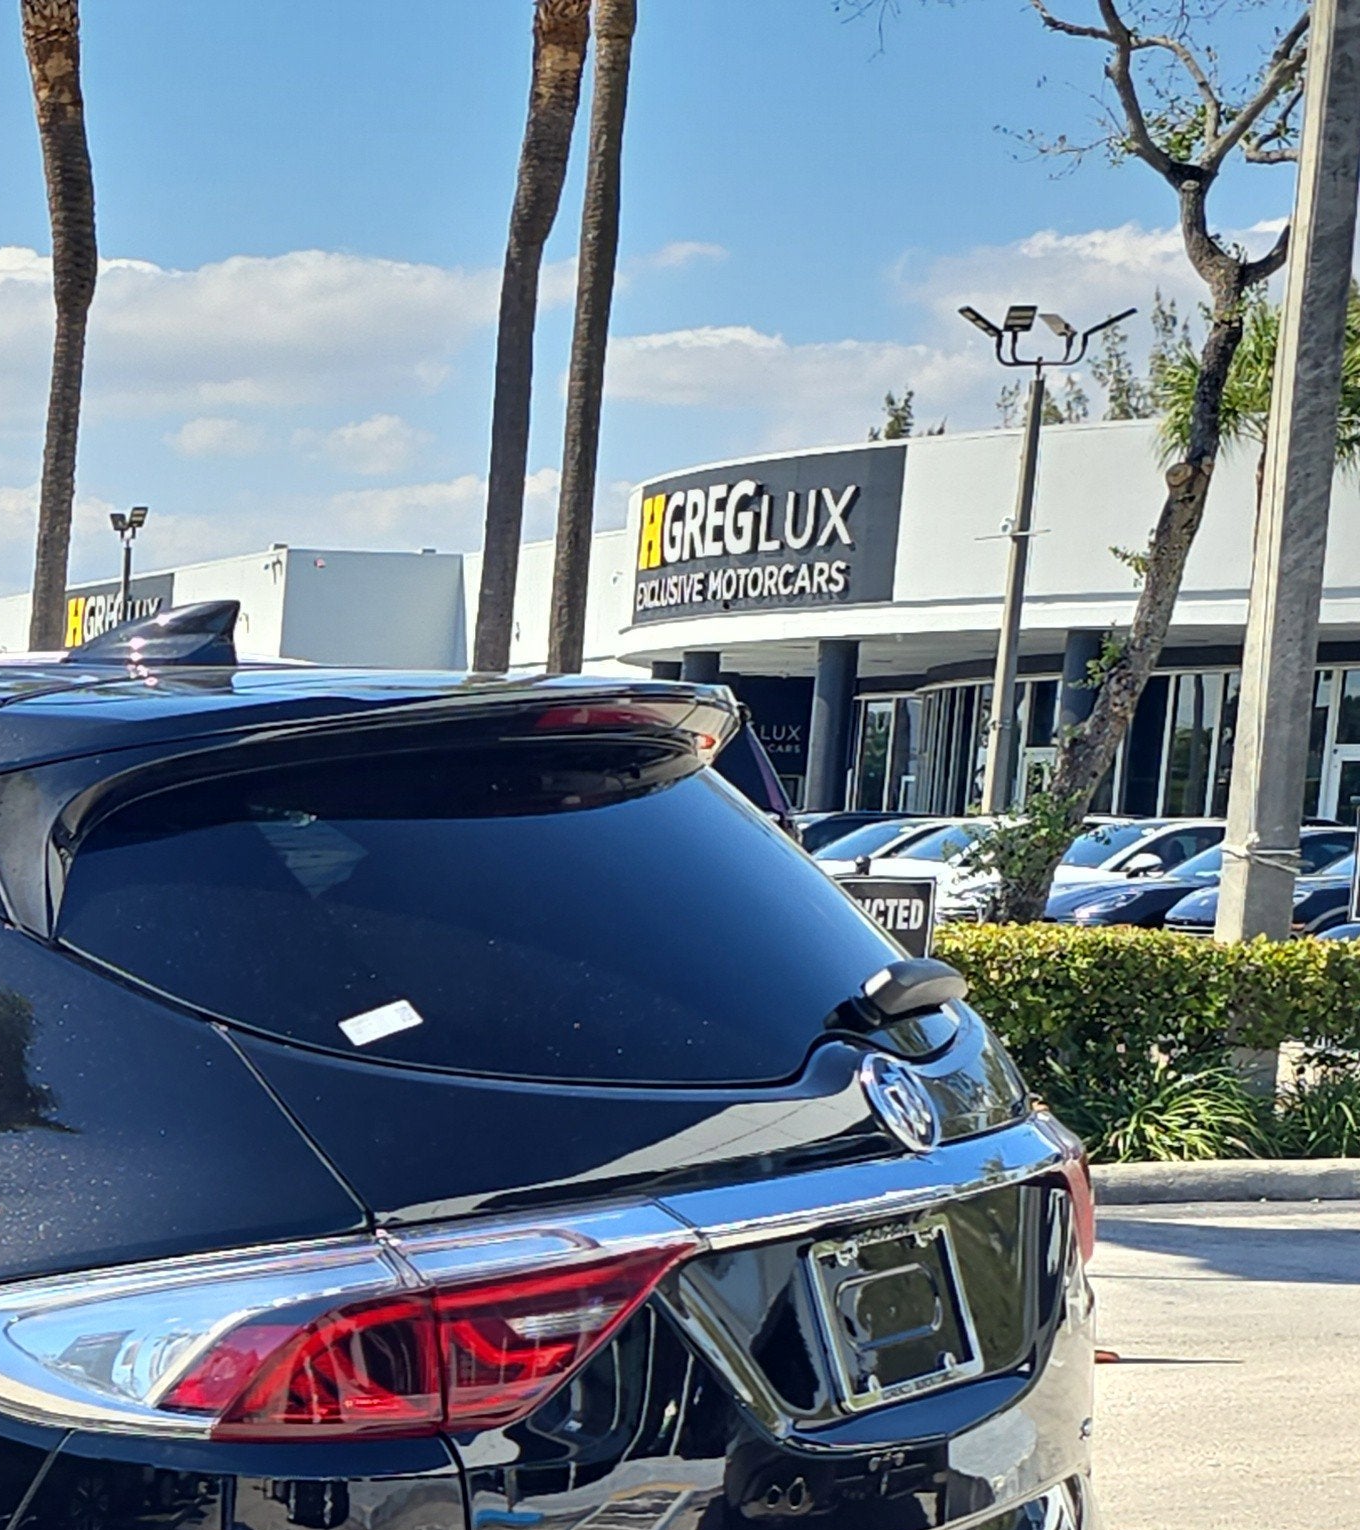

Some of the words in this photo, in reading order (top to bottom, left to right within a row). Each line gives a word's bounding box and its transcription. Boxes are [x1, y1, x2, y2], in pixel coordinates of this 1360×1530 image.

[758, 484, 857, 551] LUX
[636, 571, 705, 612] EXCLUSIVE
[707, 559, 847, 601] MOTORCARS
[760, 725, 801, 741] LUX
